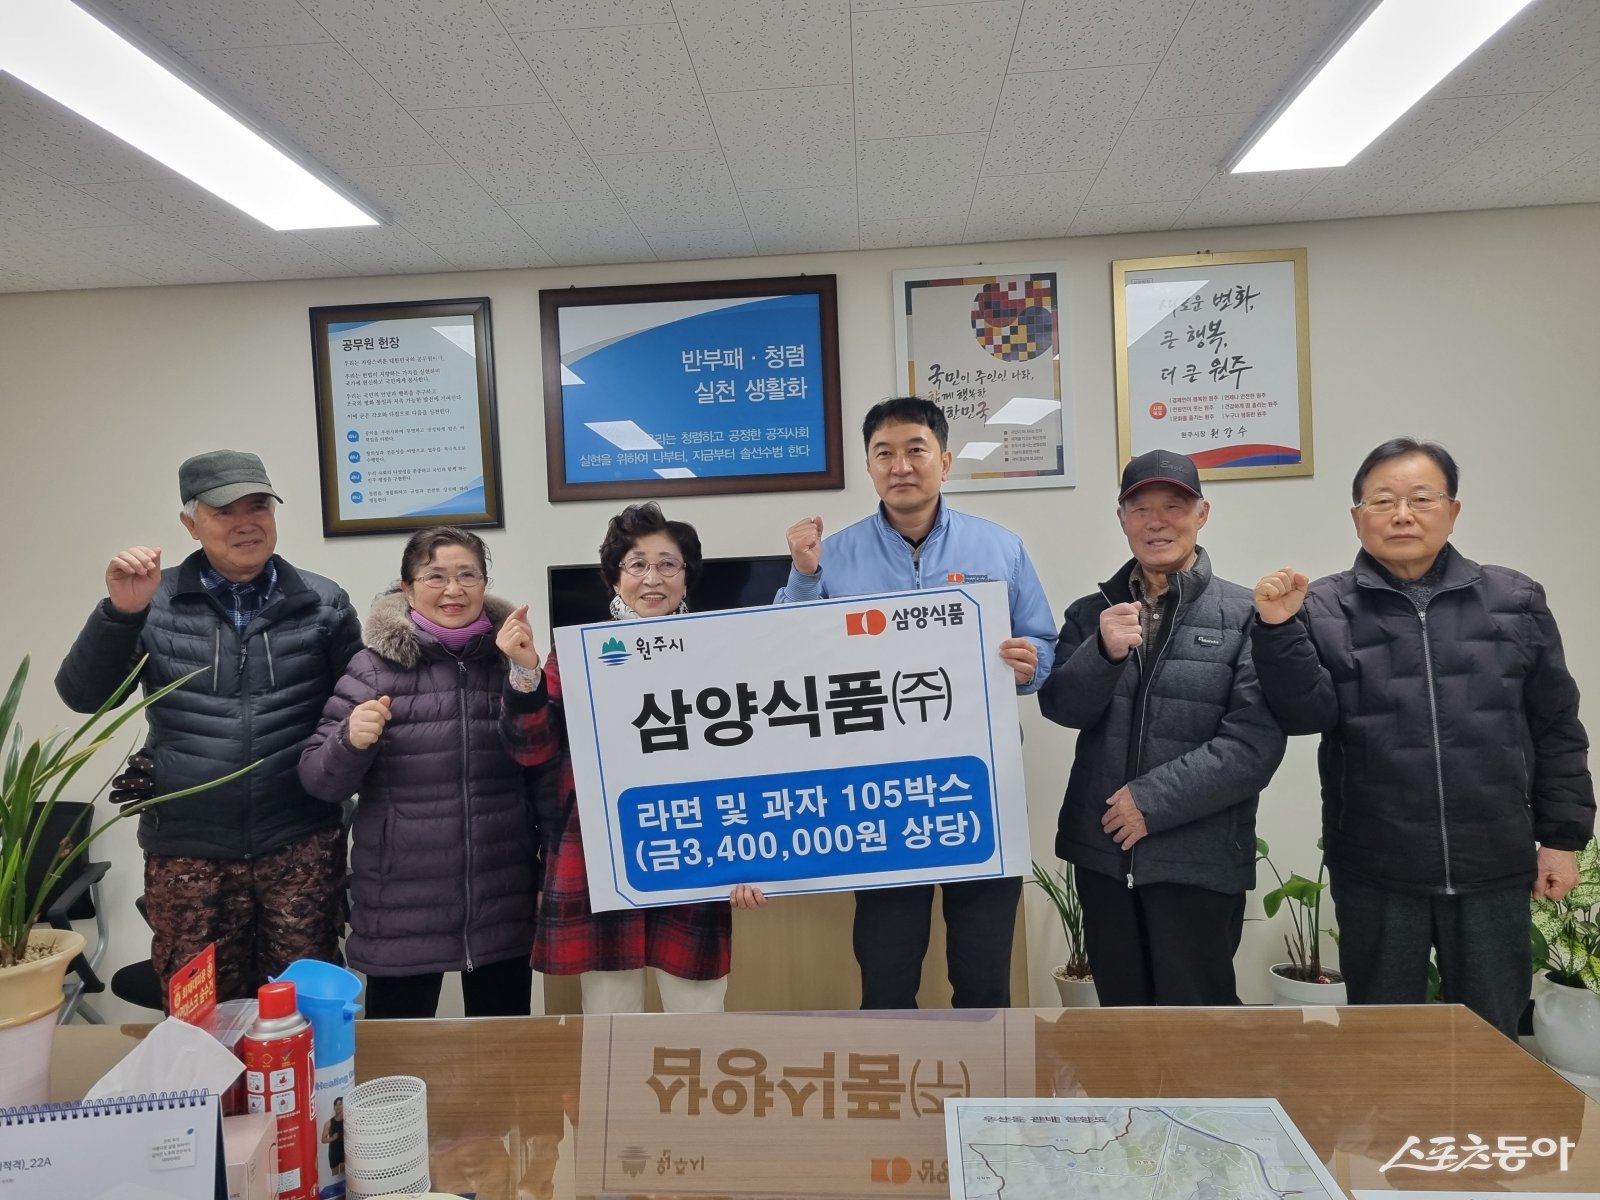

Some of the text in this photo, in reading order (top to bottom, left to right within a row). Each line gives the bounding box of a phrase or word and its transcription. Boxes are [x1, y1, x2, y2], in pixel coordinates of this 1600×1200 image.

[1213, 285, 1260, 314] 변화,
[341, 336, 400, 351] 공무원 헌장
[1160, 319, 1228, 354] 큰 행복,
[681, 344, 806, 373] 반부패 청렴
[1161, 355, 1253, 389] 더 큰 원주
[694, 376, 808, 404] 실천 생활화
[927, 363, 1035, 390] 국민이 주인인 나라,
[940, 401, 990, 428] 한민국
[648, 426, 809, 446] 리는 청렴하고 공정한 공직사회
[579, 444, 811, 468] 실현을 위하여 나부터, 지금부터 솔선수범 한다
[891, 603, 965, 631] 삼양식품
[635, 636, 685, 661] 원주시
[637, 773, 974, 833] 라면 및 과자 105박스
[635, 810, 982, 872] (금3,400,000원 상당)
[0, 1157, 52, 1172] 적격)_22A
